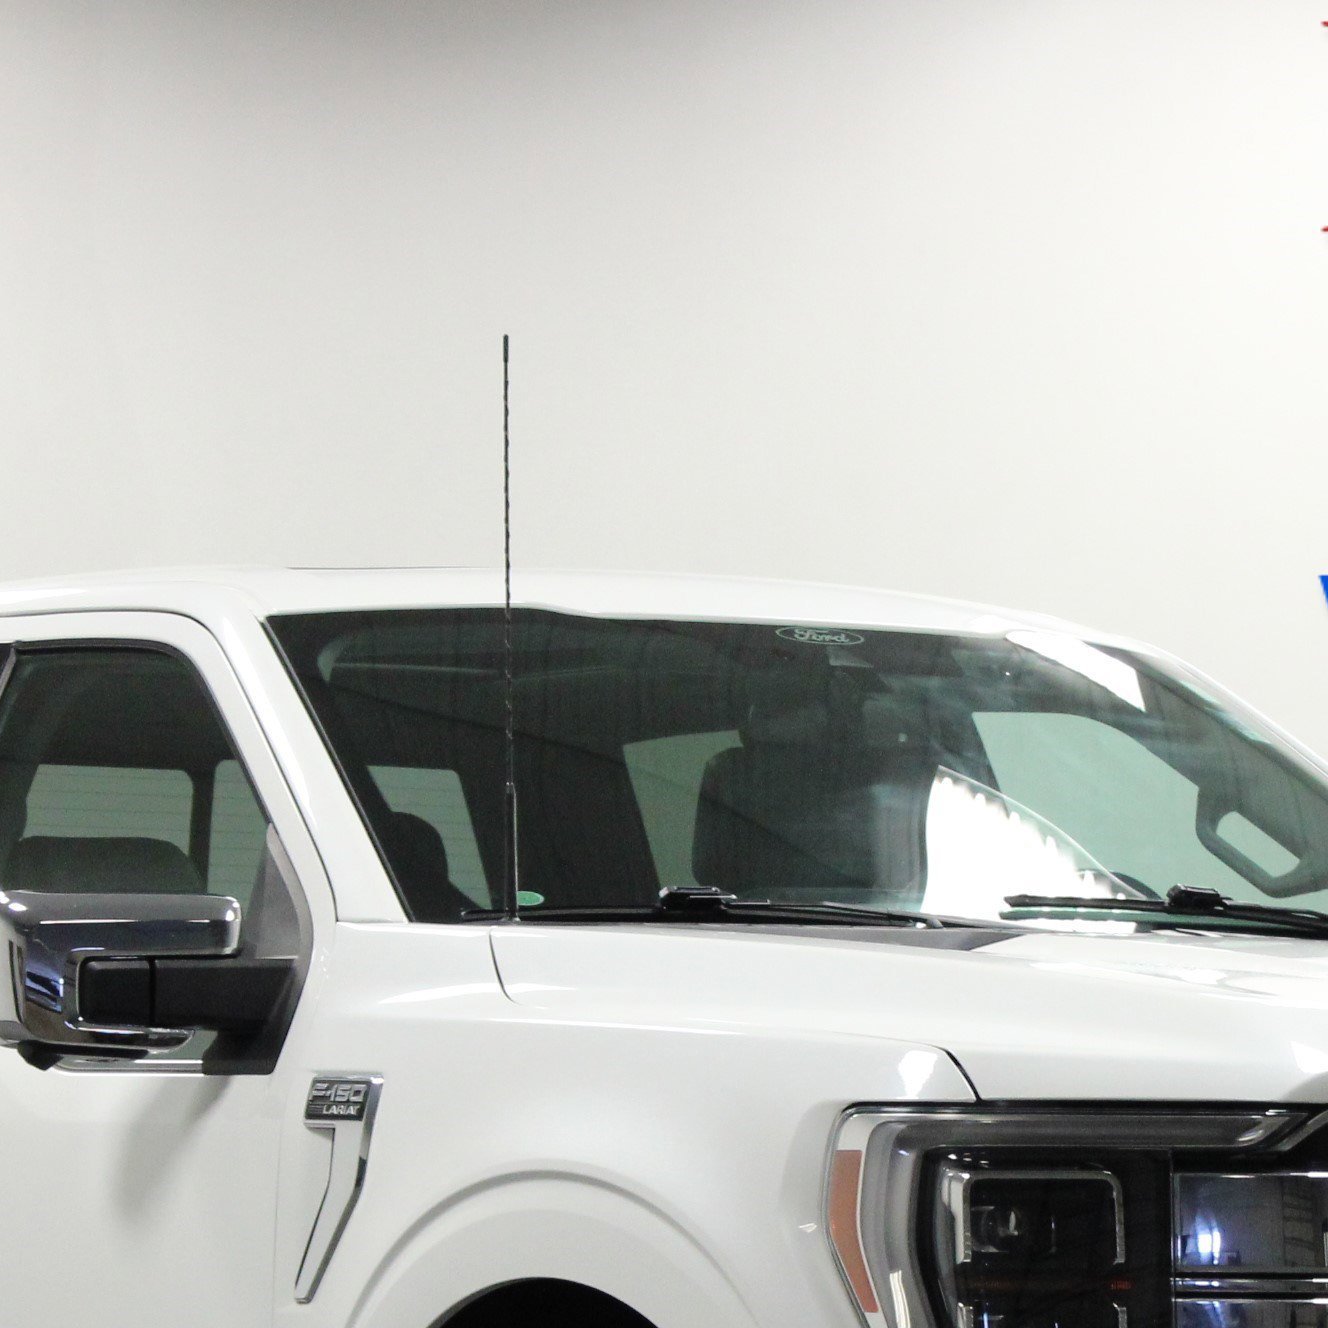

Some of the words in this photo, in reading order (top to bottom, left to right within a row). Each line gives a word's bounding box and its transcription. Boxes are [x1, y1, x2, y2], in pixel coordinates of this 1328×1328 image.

[793, 628, 850, 644] Ford
[309, 1082, 368, 1103] F-150
[322, 1104, 361, 1116] LARIAT
